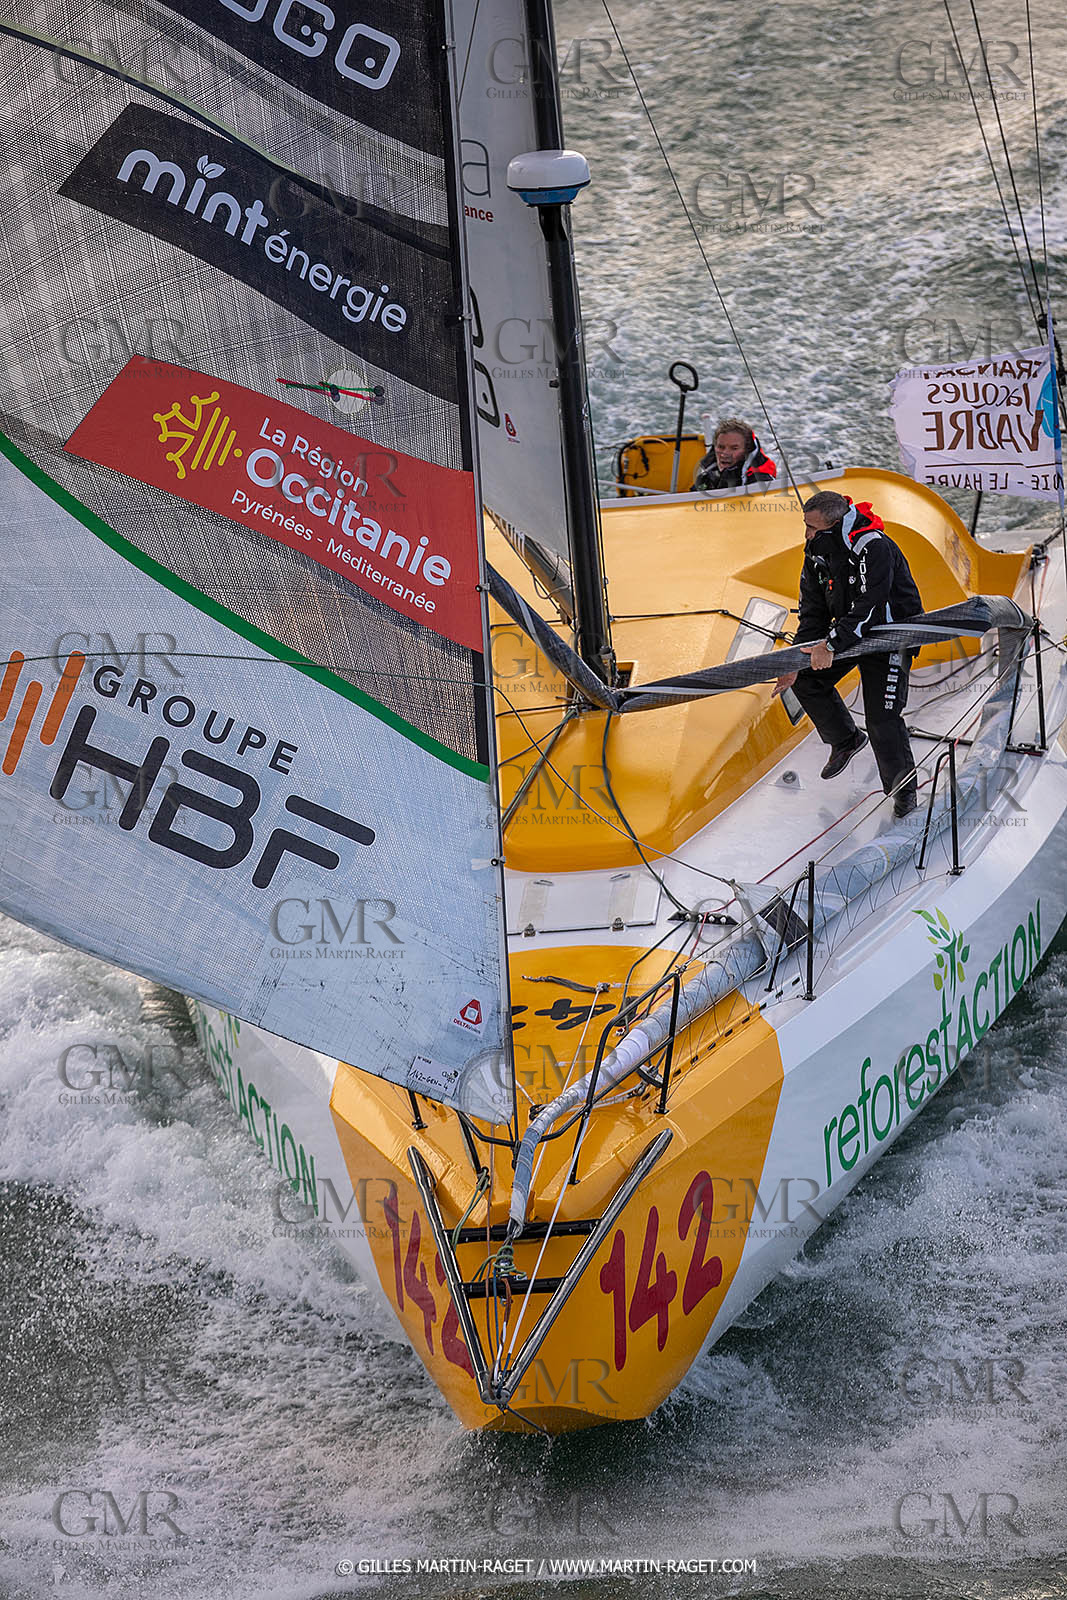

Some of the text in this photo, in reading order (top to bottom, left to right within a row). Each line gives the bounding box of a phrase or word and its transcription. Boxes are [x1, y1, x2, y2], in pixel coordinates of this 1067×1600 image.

[116, 148, 408, 333] mint énergie
[246, 447, 452, 586] Occitanie
[259, 416, 370, 498] La Région
[231, 490, 314, 542] Pyrénées
[327, 536, 436, 613] Méditerranée
[93, 664, 299, 776] GROUPE
[49, 704, 376, 890] HBF
[600, 1170, 724, 1372] 142
